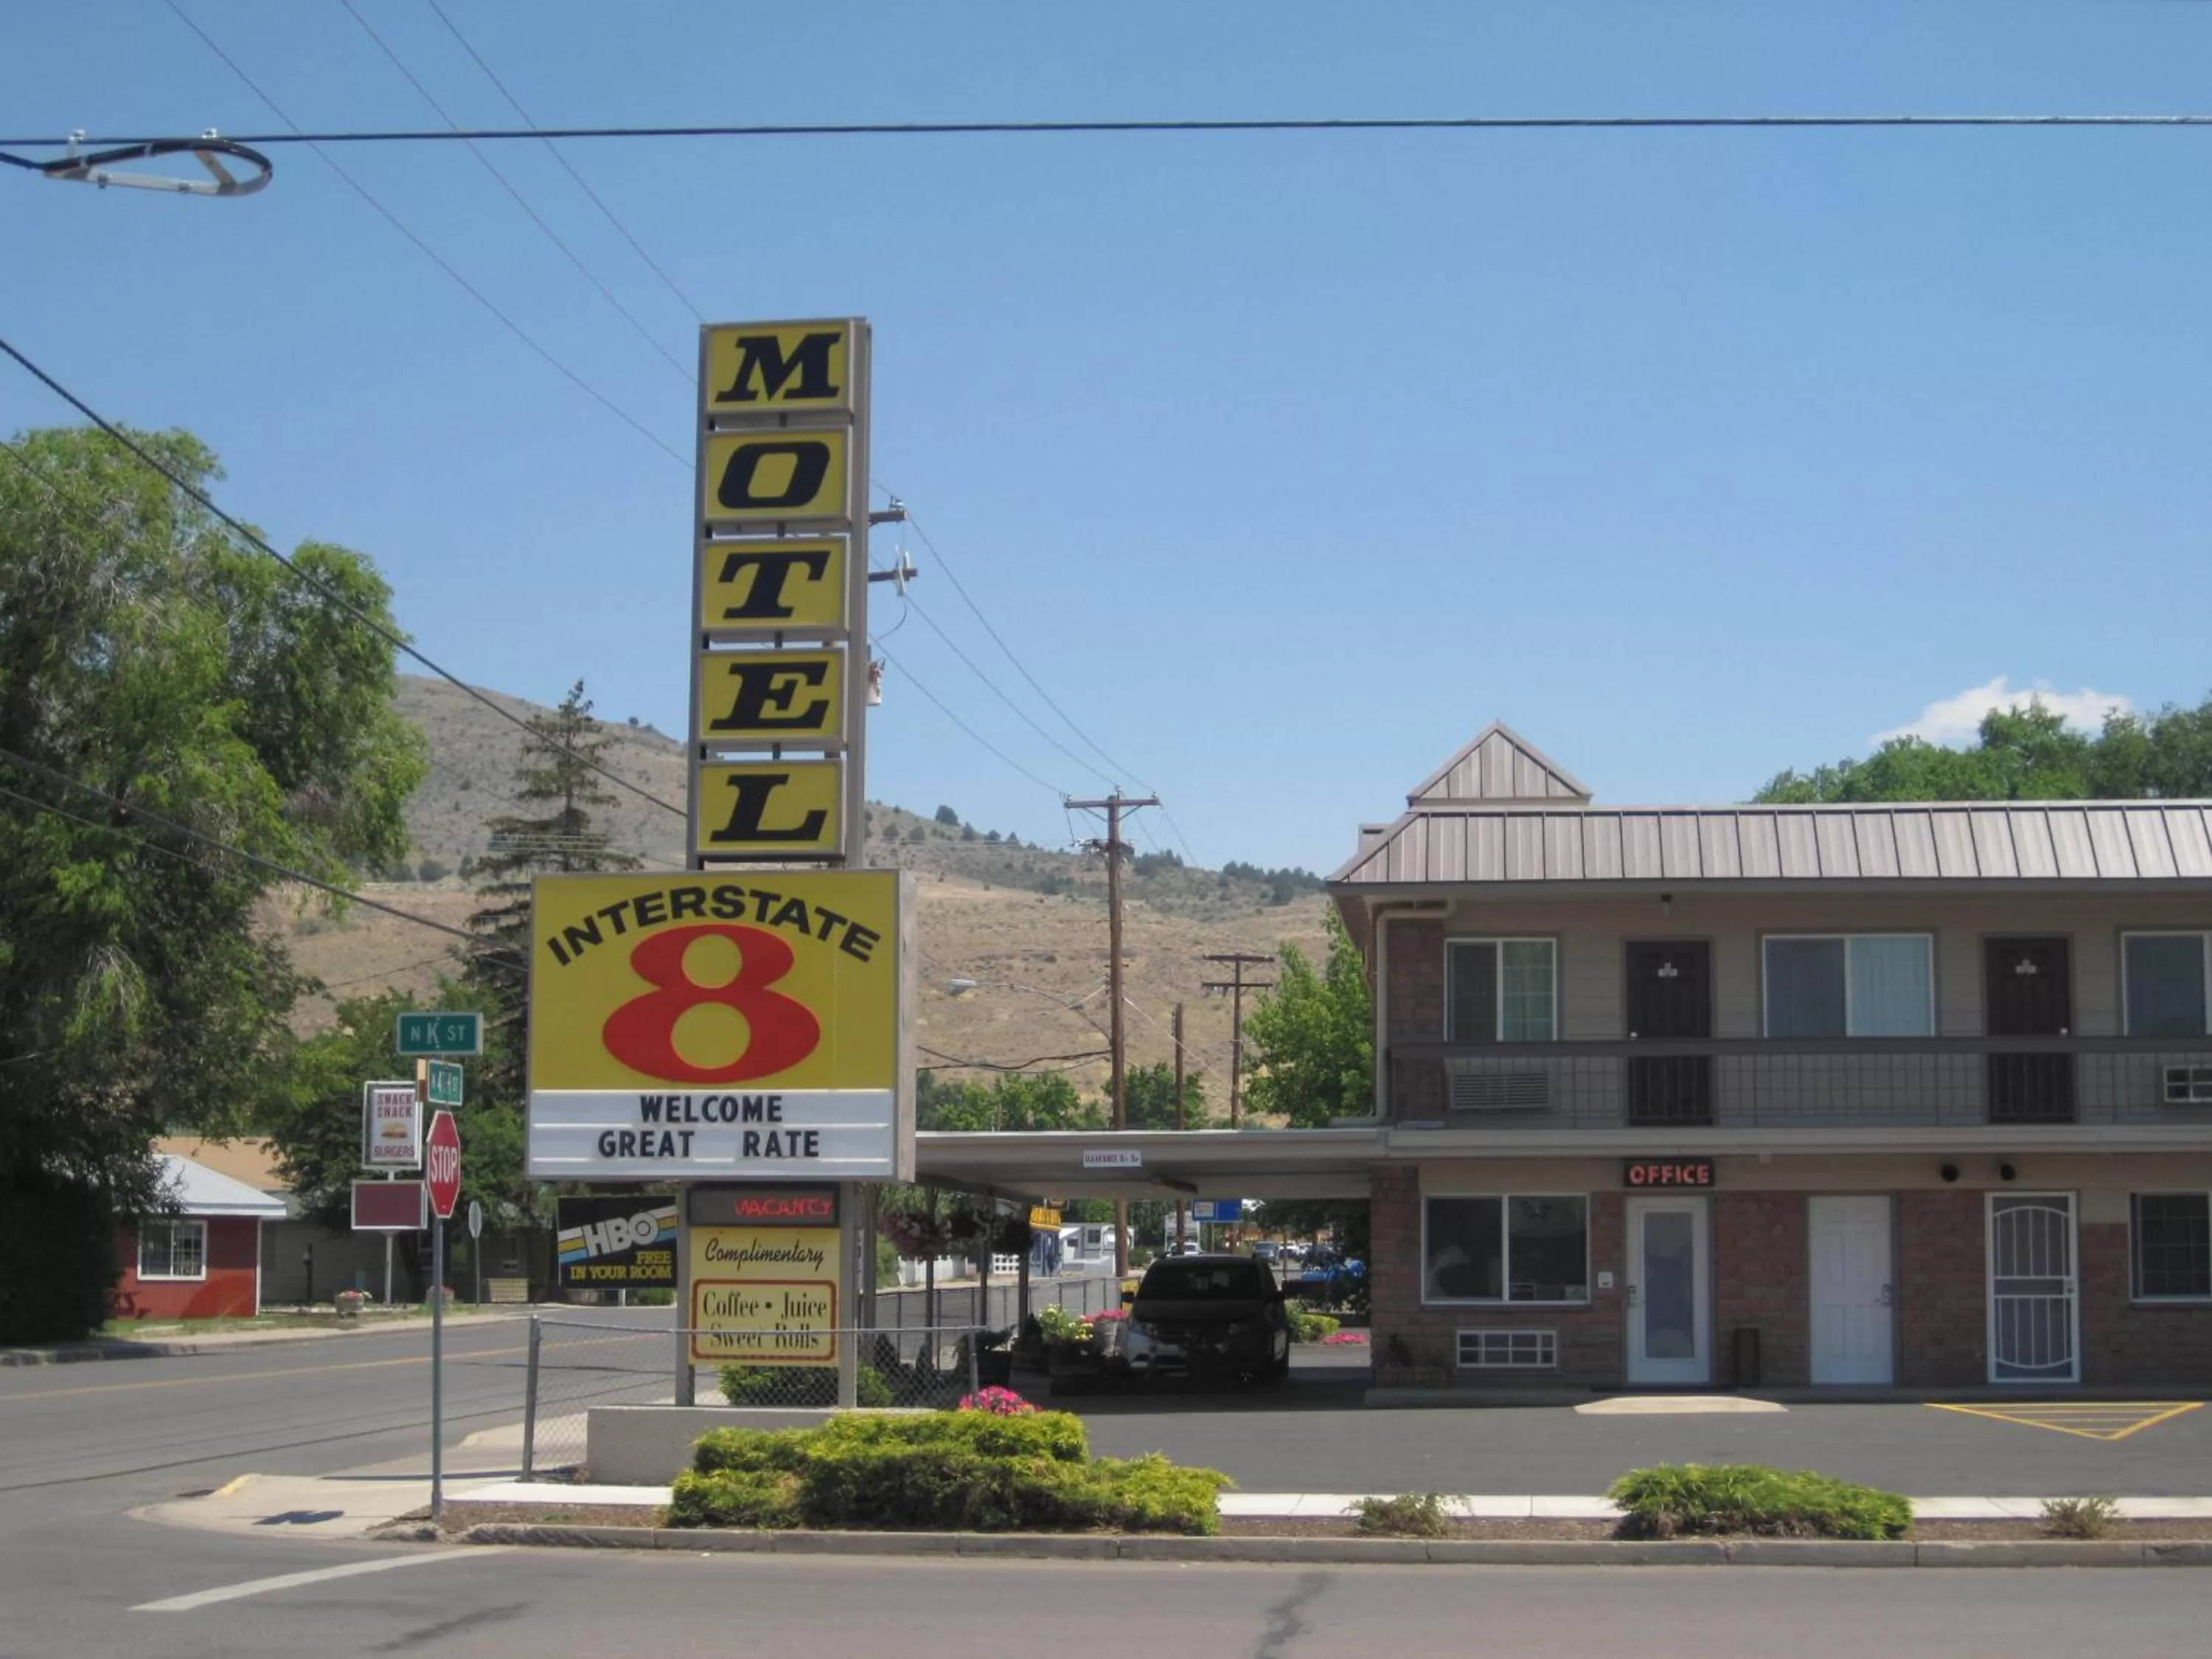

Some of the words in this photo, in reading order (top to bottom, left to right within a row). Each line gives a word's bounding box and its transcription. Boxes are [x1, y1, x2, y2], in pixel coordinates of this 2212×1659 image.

[709, 332, 841, 843] MOTEL
[546, 885, 880, 967] INTERSTATE
[602, 923, 821, 1084] 8
[411, 1026, 420, 1041] N
[427, 1022, 439, 1045] K
[448, 1024, 465, 1041] ST
[640, 1096, 782, 1122] WELCOME
[374, 1145, 415, 1157] BURGERS
[599, 1130, 695, 1158] GREAT
[742, 1130, 820, 1158] RATE
[431, 1146, 458, 1183] STOP
[1630, 1164, 1709, 1184] OFFICE
[734, 1198, 834, 1216] VACANCY
[582, 1211, 658, 1256] HBO
[636, 1251, 672, 1265] FREE
[705, 1237, 827, 1272] Complimentary
[570, 1266, 587, 1280] IN
[589, 1265, 627, 1279] YOUR
[630, 1265, 672, 1279] ROOM
[703, 1290, 759, 1318] Coffee
[780, 1290, 827, 1321] Juice
[709, 1321, 762, 1349] Sweet
[775, 1321, 820, 1349] Rolls
